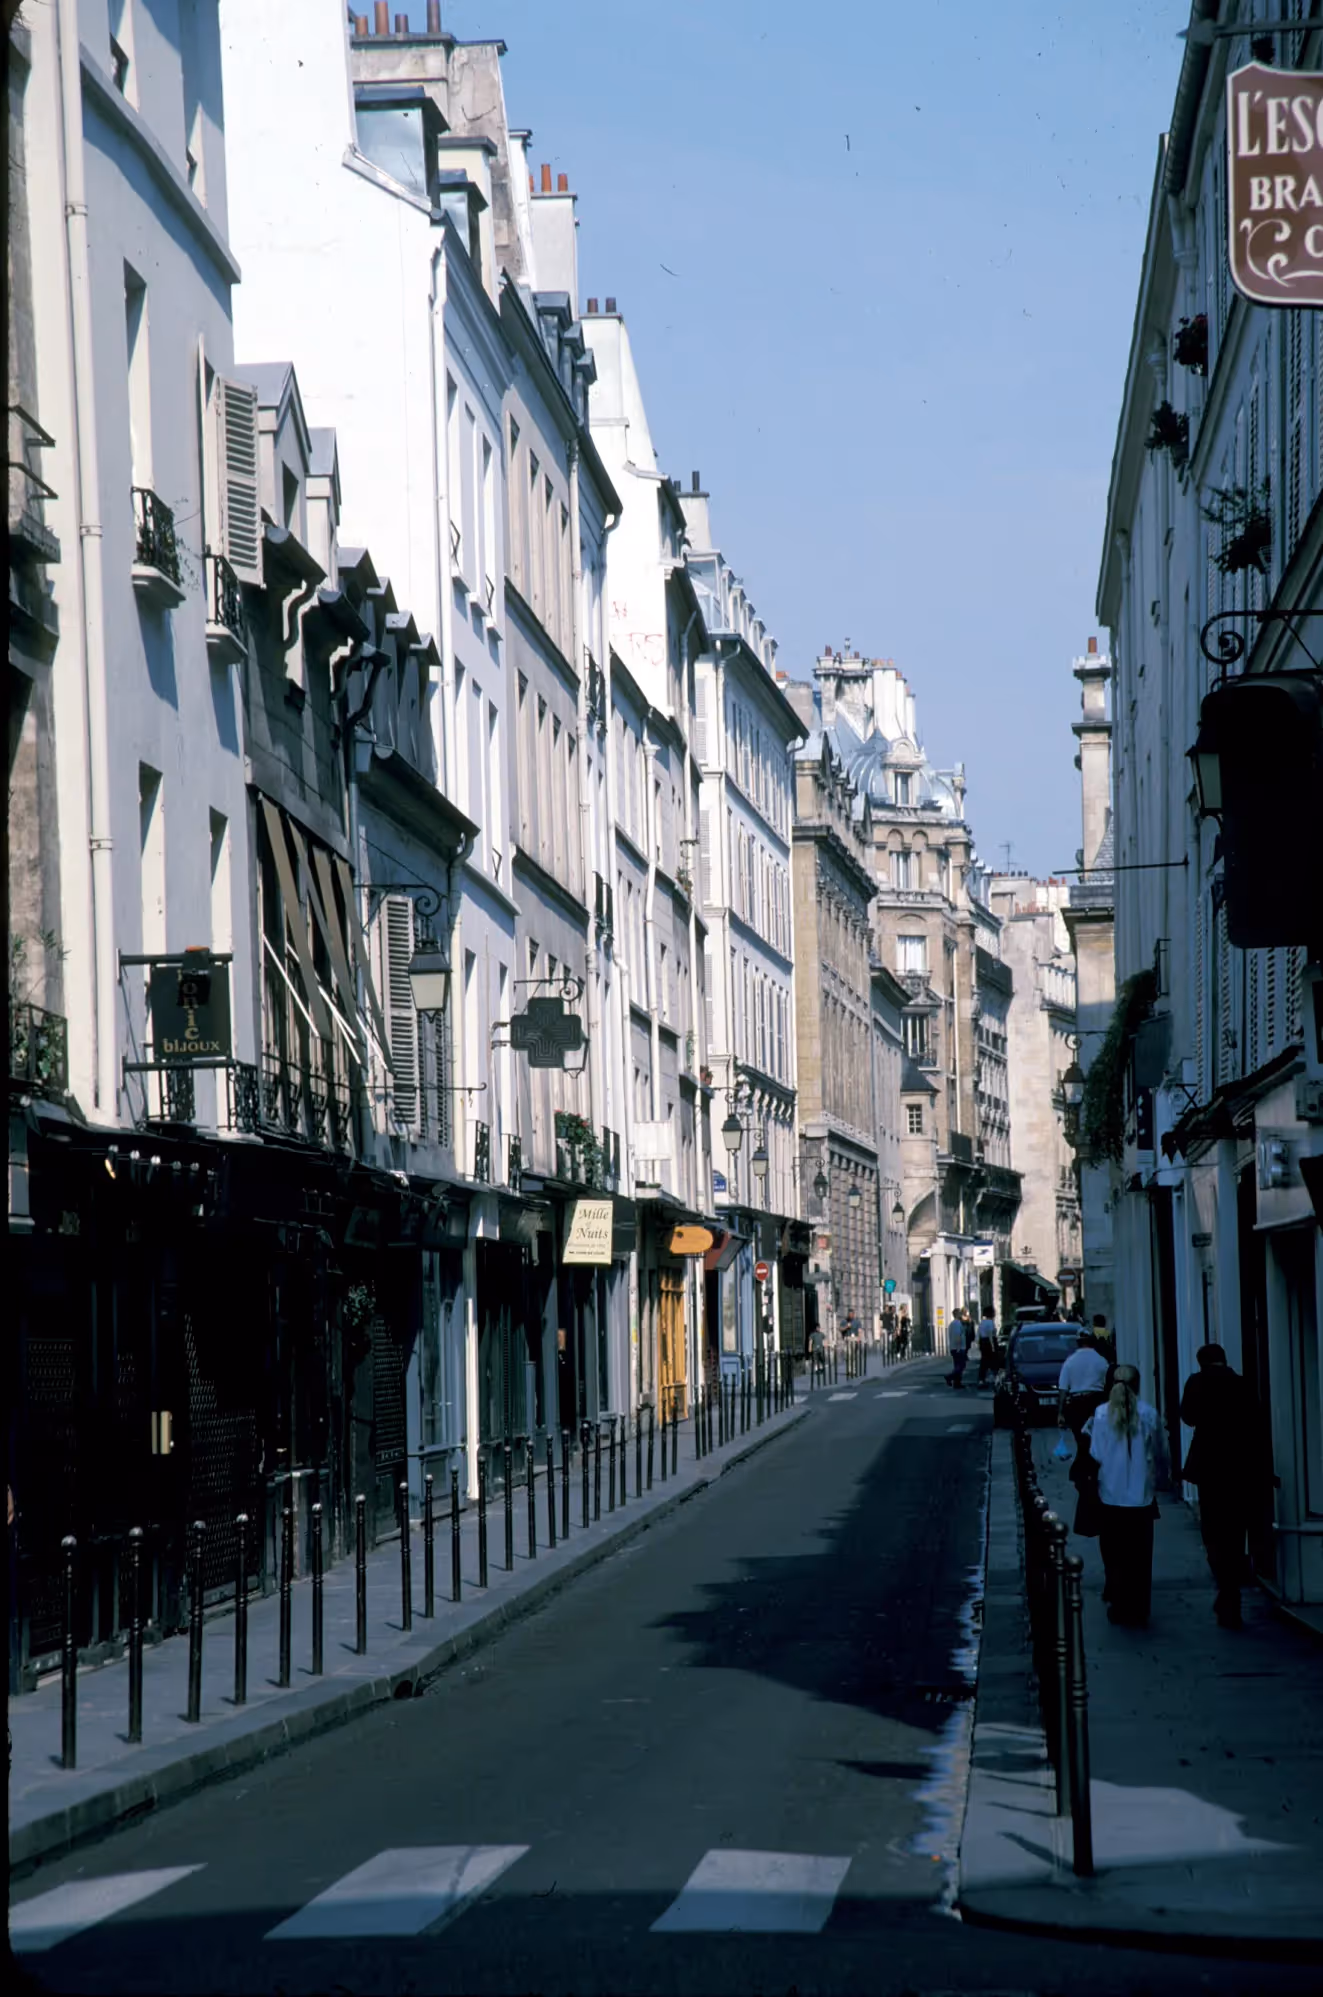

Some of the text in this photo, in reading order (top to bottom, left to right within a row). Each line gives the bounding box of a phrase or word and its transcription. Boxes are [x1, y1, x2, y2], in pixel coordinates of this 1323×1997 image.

[1250, 174, 1323, 212] BRA
[578, 1207, 610, 1220] Mille
[576, 1227, 609, 1240] Nuits
